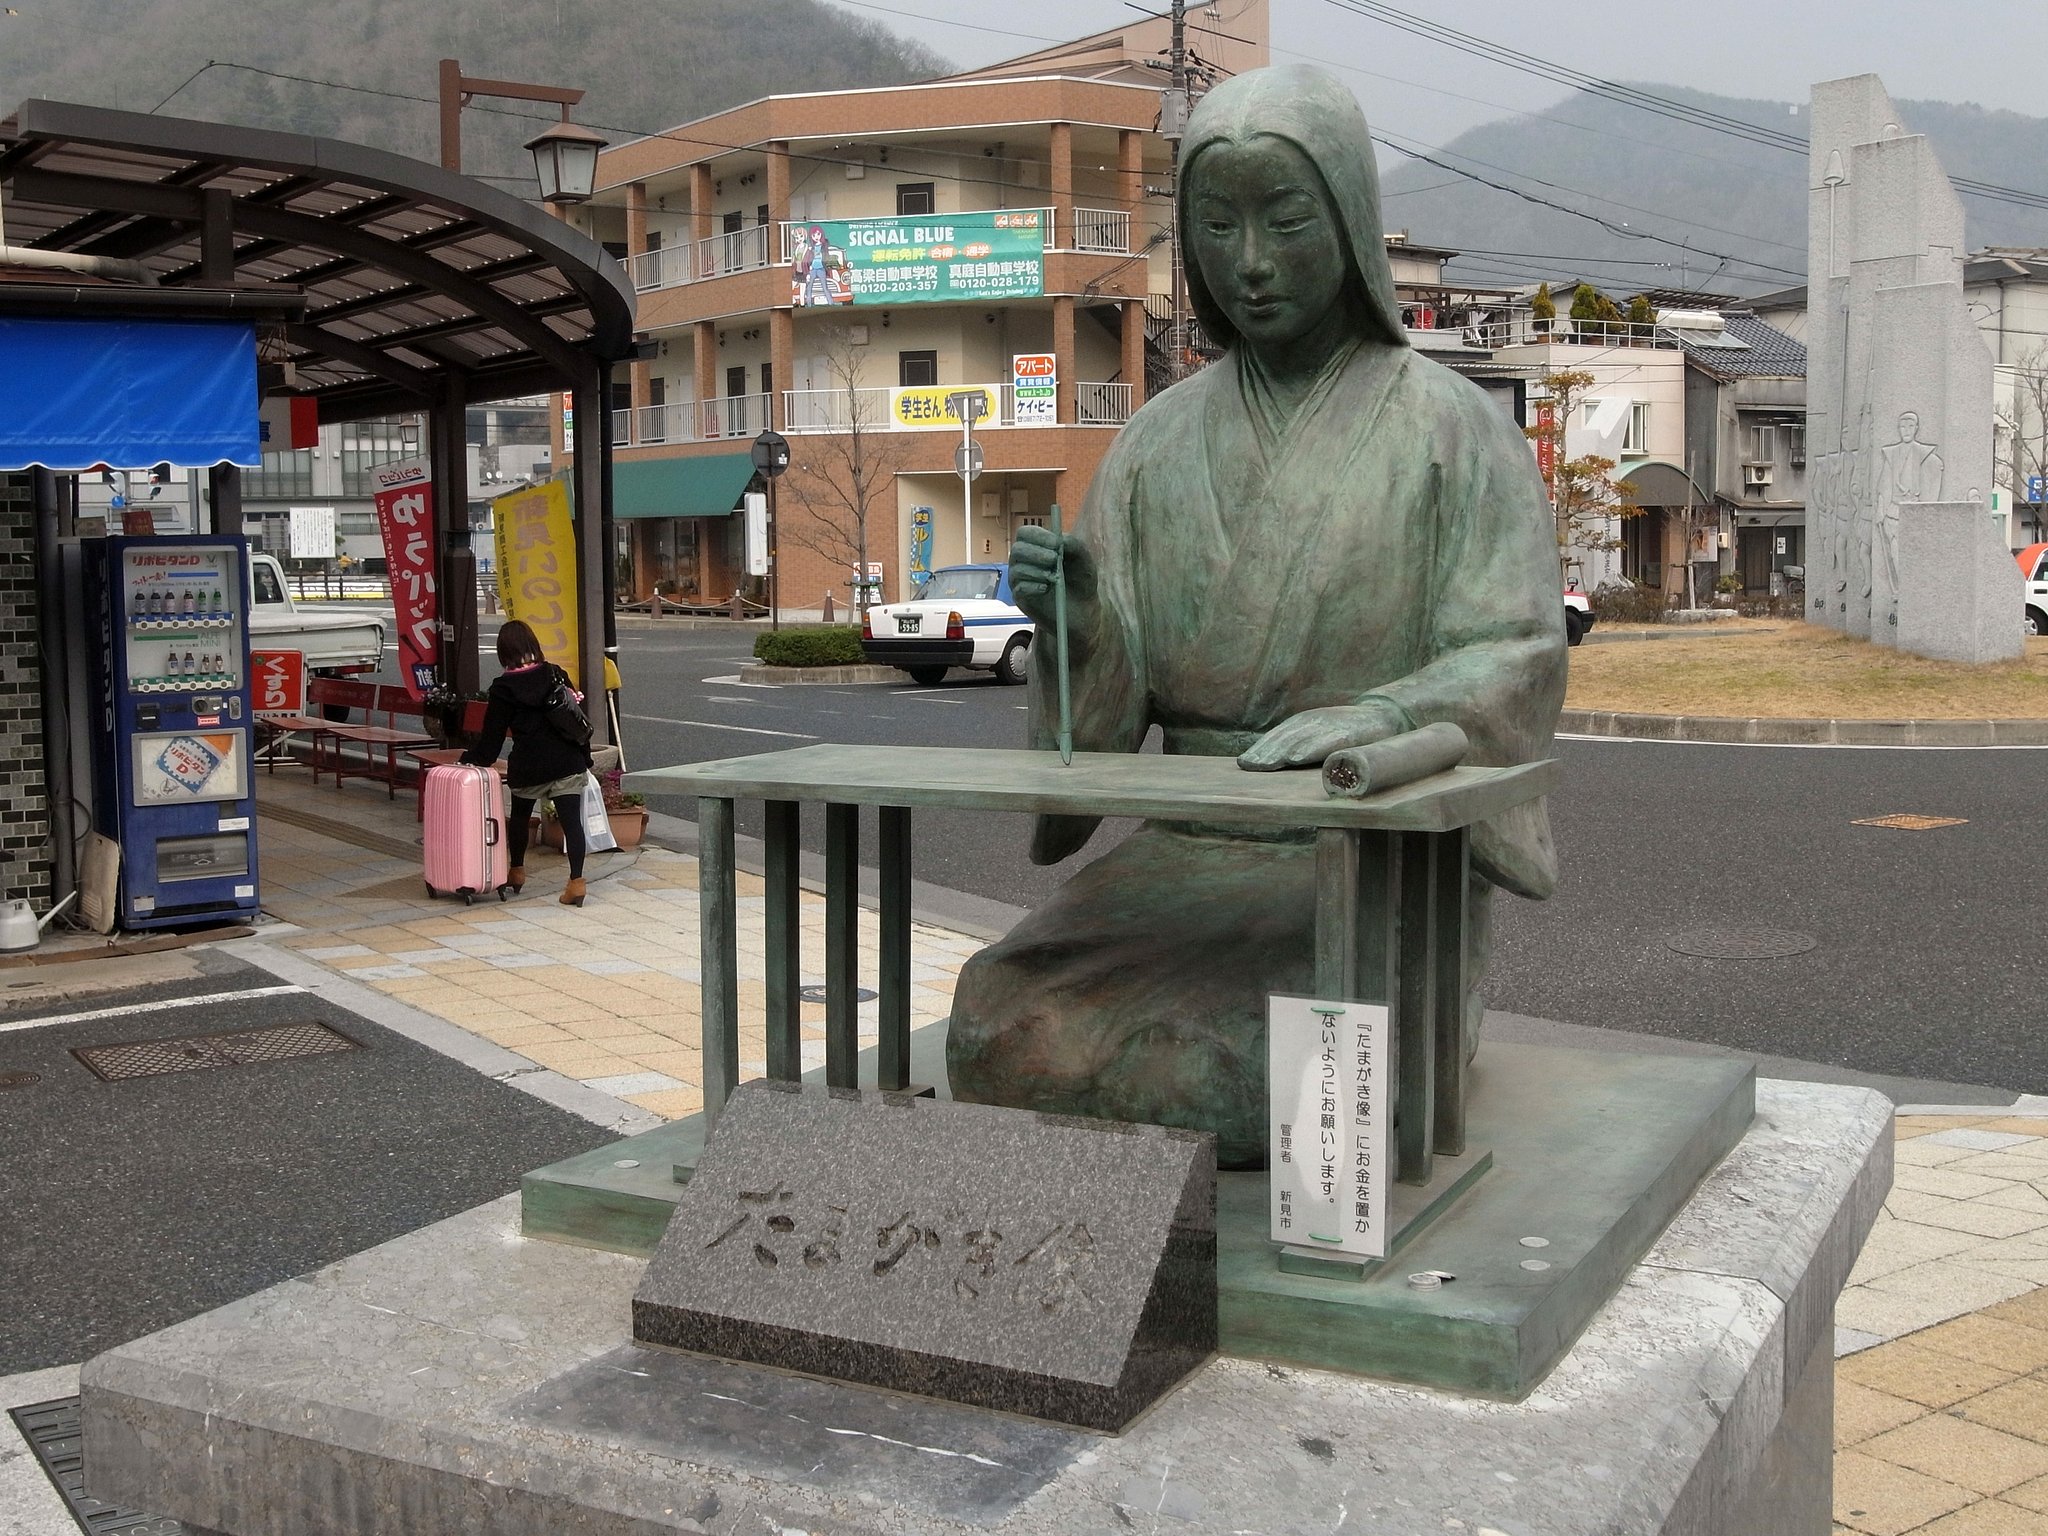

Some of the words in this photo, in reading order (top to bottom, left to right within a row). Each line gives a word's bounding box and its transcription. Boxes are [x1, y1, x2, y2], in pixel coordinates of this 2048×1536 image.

[849, 228, 909, 247] SIGNAL
[914, 227, 955, 243] BLUE
[871, 248, 926, 263] 運転免許
[850, 265, 938, 283] 高梁自動車学校
[949, 260, 1039, 279] 真庭自動車学校
[860, 280, 938, 293] 0120-203-357
[959, 276, 1039, 289] 0120-028-179
[1017, 359, 1053, 375] アパート
[901, 395, 942, 420] 学生さん
[132, 554, 200, 567] リポビタンD
[263, 656, 290, 708] くすり
[170, 747, 205, 775] リポビタン
[176, 763, 189, 774] D
[1320, 1012, 1336, 1205] ないようにお願いします。
[1354, 1022, 1372, 1234] 『たまがき像』にお金を置か
[1279, 1123, 1293, 1164] 管理者
[1279, 1190, 1292, 1230] 新見市
